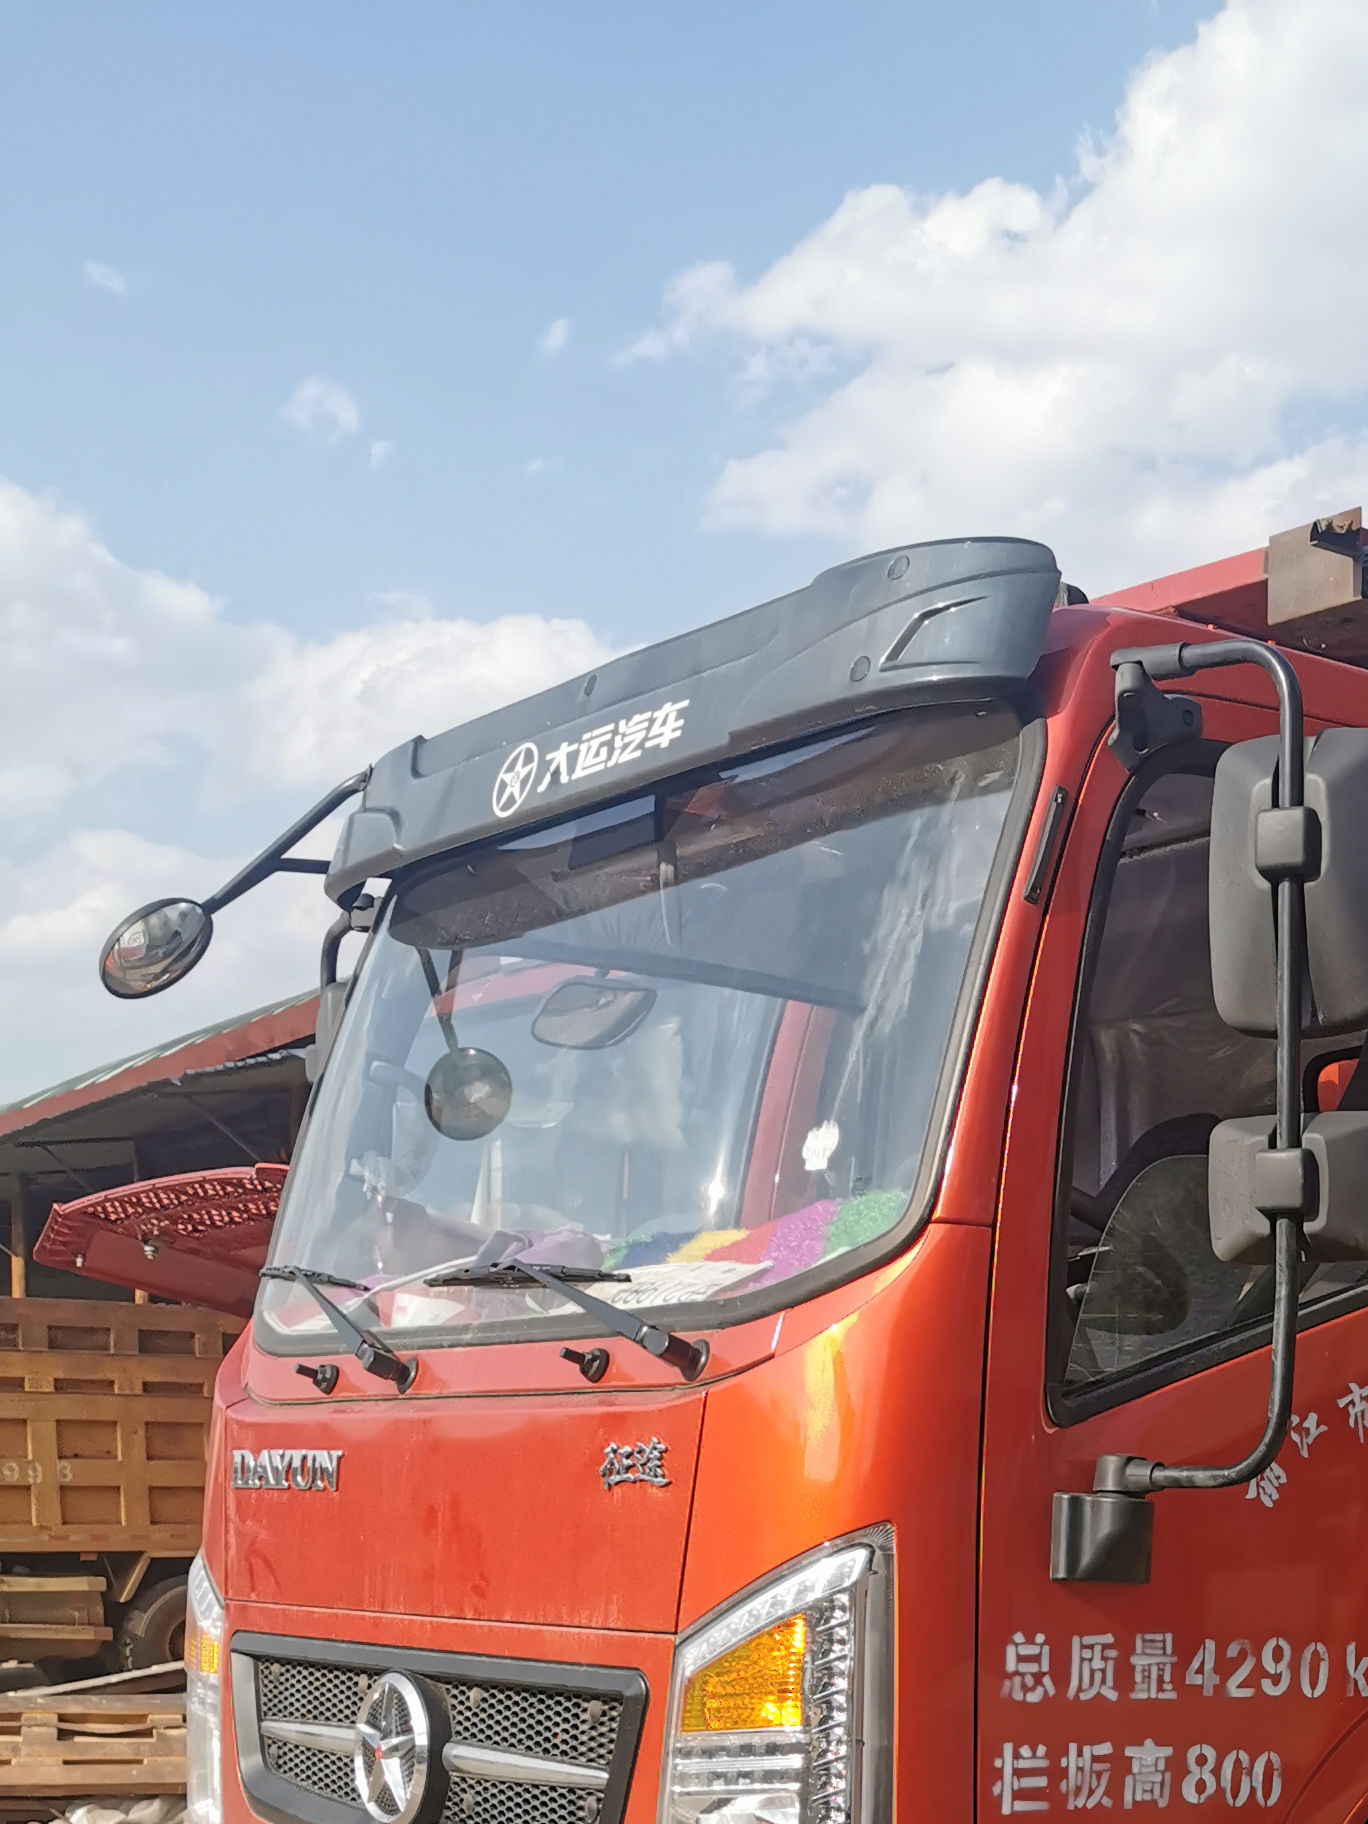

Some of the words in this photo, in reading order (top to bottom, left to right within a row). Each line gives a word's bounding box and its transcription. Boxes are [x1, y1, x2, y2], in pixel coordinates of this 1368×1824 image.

[537, 699, 690, 793] 大运汽车
[231, 1449, 345, 1492] DAYUN
[598, 1436, 673, 1492] 征途
[991, 1738, 1283, 1816] 栏板高800
